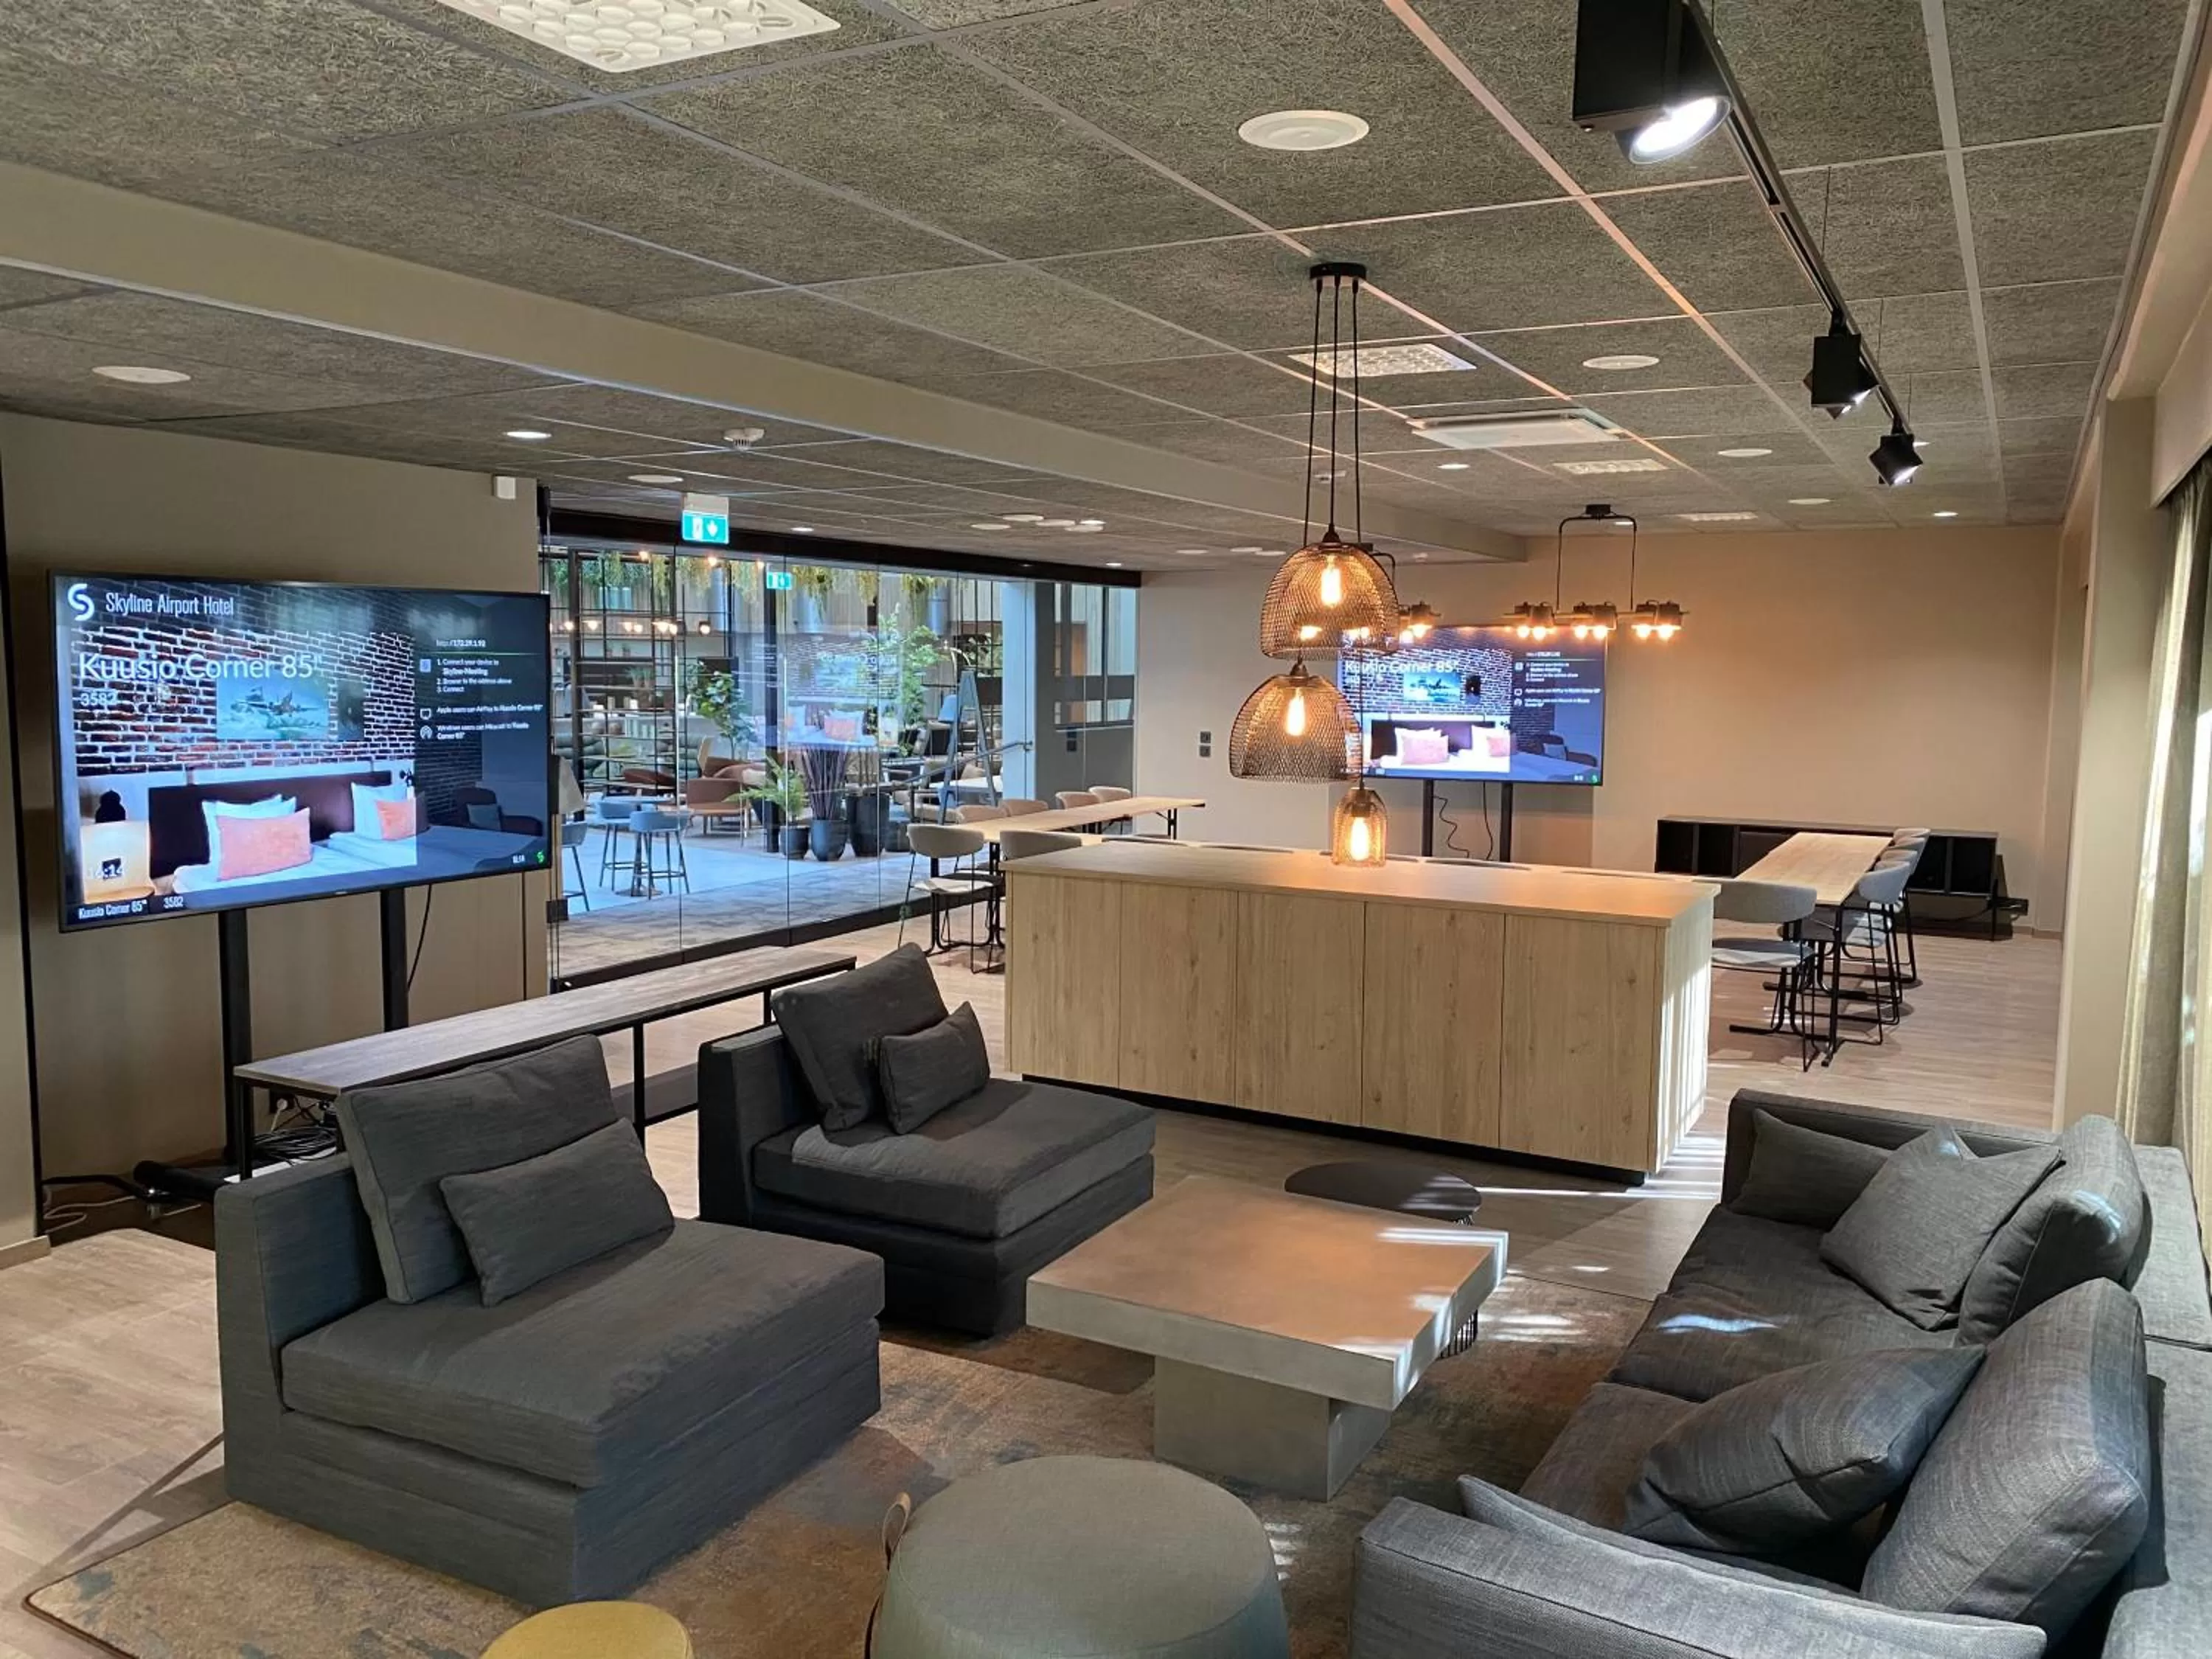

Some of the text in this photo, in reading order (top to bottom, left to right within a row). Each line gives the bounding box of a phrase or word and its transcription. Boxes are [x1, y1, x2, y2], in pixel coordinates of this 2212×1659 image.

[105, 592, 234, 617] Skyline Airport Hotel
[79, 653, 322, 680] Kuusio Corner 85"
[1390, 660, 1432, 673] Corner
